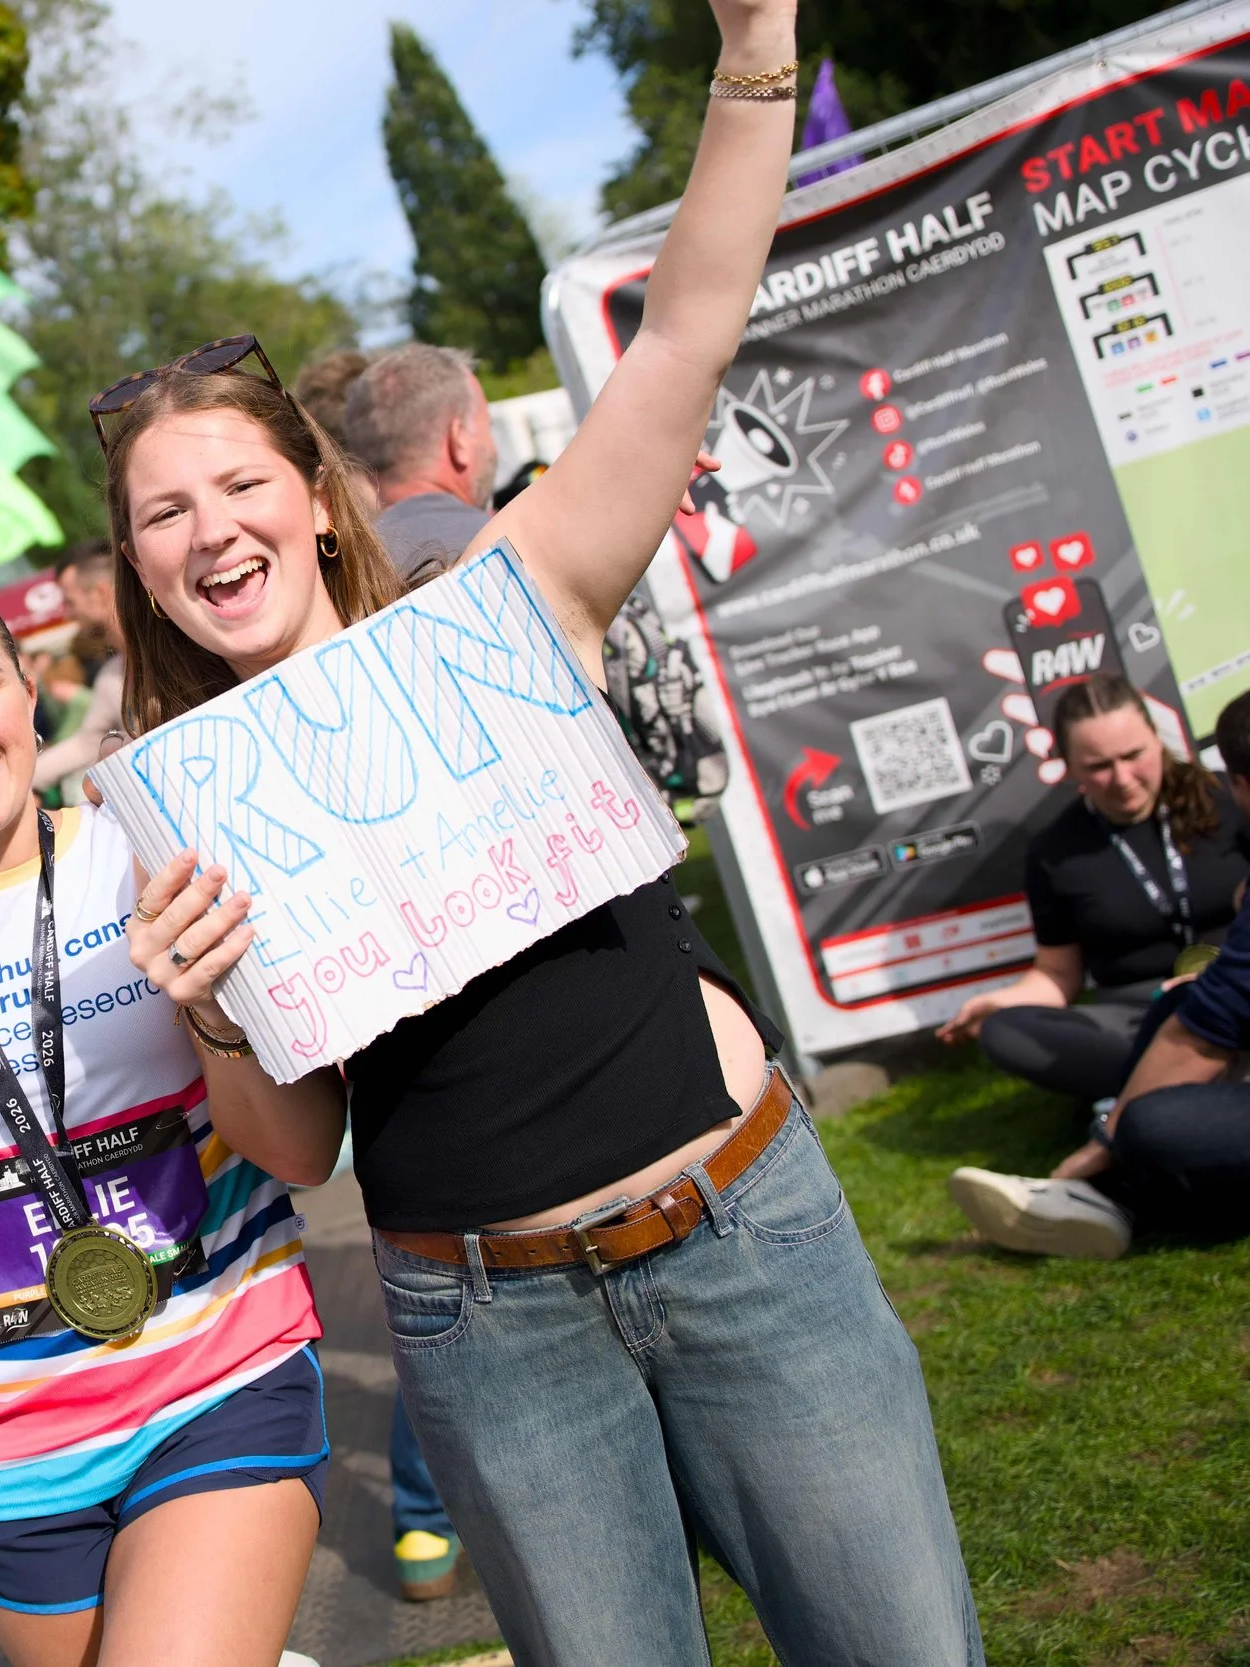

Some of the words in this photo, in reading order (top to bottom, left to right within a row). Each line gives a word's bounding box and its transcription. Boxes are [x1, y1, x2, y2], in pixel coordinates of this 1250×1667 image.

[1020, 107, 1166, 194] START
[1033, 170, 1133, 237] MAP
[749, 238, 881, 317] ARDIFF
[887, 192, 995, 262] HALF
[802, 267, 907, 322] MARATHON
[907, 232, 1006, 285] CAERDYDD
[1032, 634, 1105, 685] R4W
[131, 546, 594, 900] RUN
[807, 784, 853, 808] Scan
[247, 873, 377, 969] Ellie
[268, 931, 390, 1059] you
[546, 779, 641, 908] fit
[41, 920, 57, 968] CARDIFF
[42, 971, 55, 1002] HALF
[42, 1029, 55, 1068] 2026
[5, 1097, 32, 1135] 2026
[96, 1127, 139, 1153] HALF
[104, 1143, 144, 1161] CAERDYDD
[32, 1156, 55, 1190] HALF
[42, 1152, 60, 1182] CAERDYDD
[48, 1188, 76, 1231] ARDIFF
[13, 1288, 45, 1302] PURPLE
